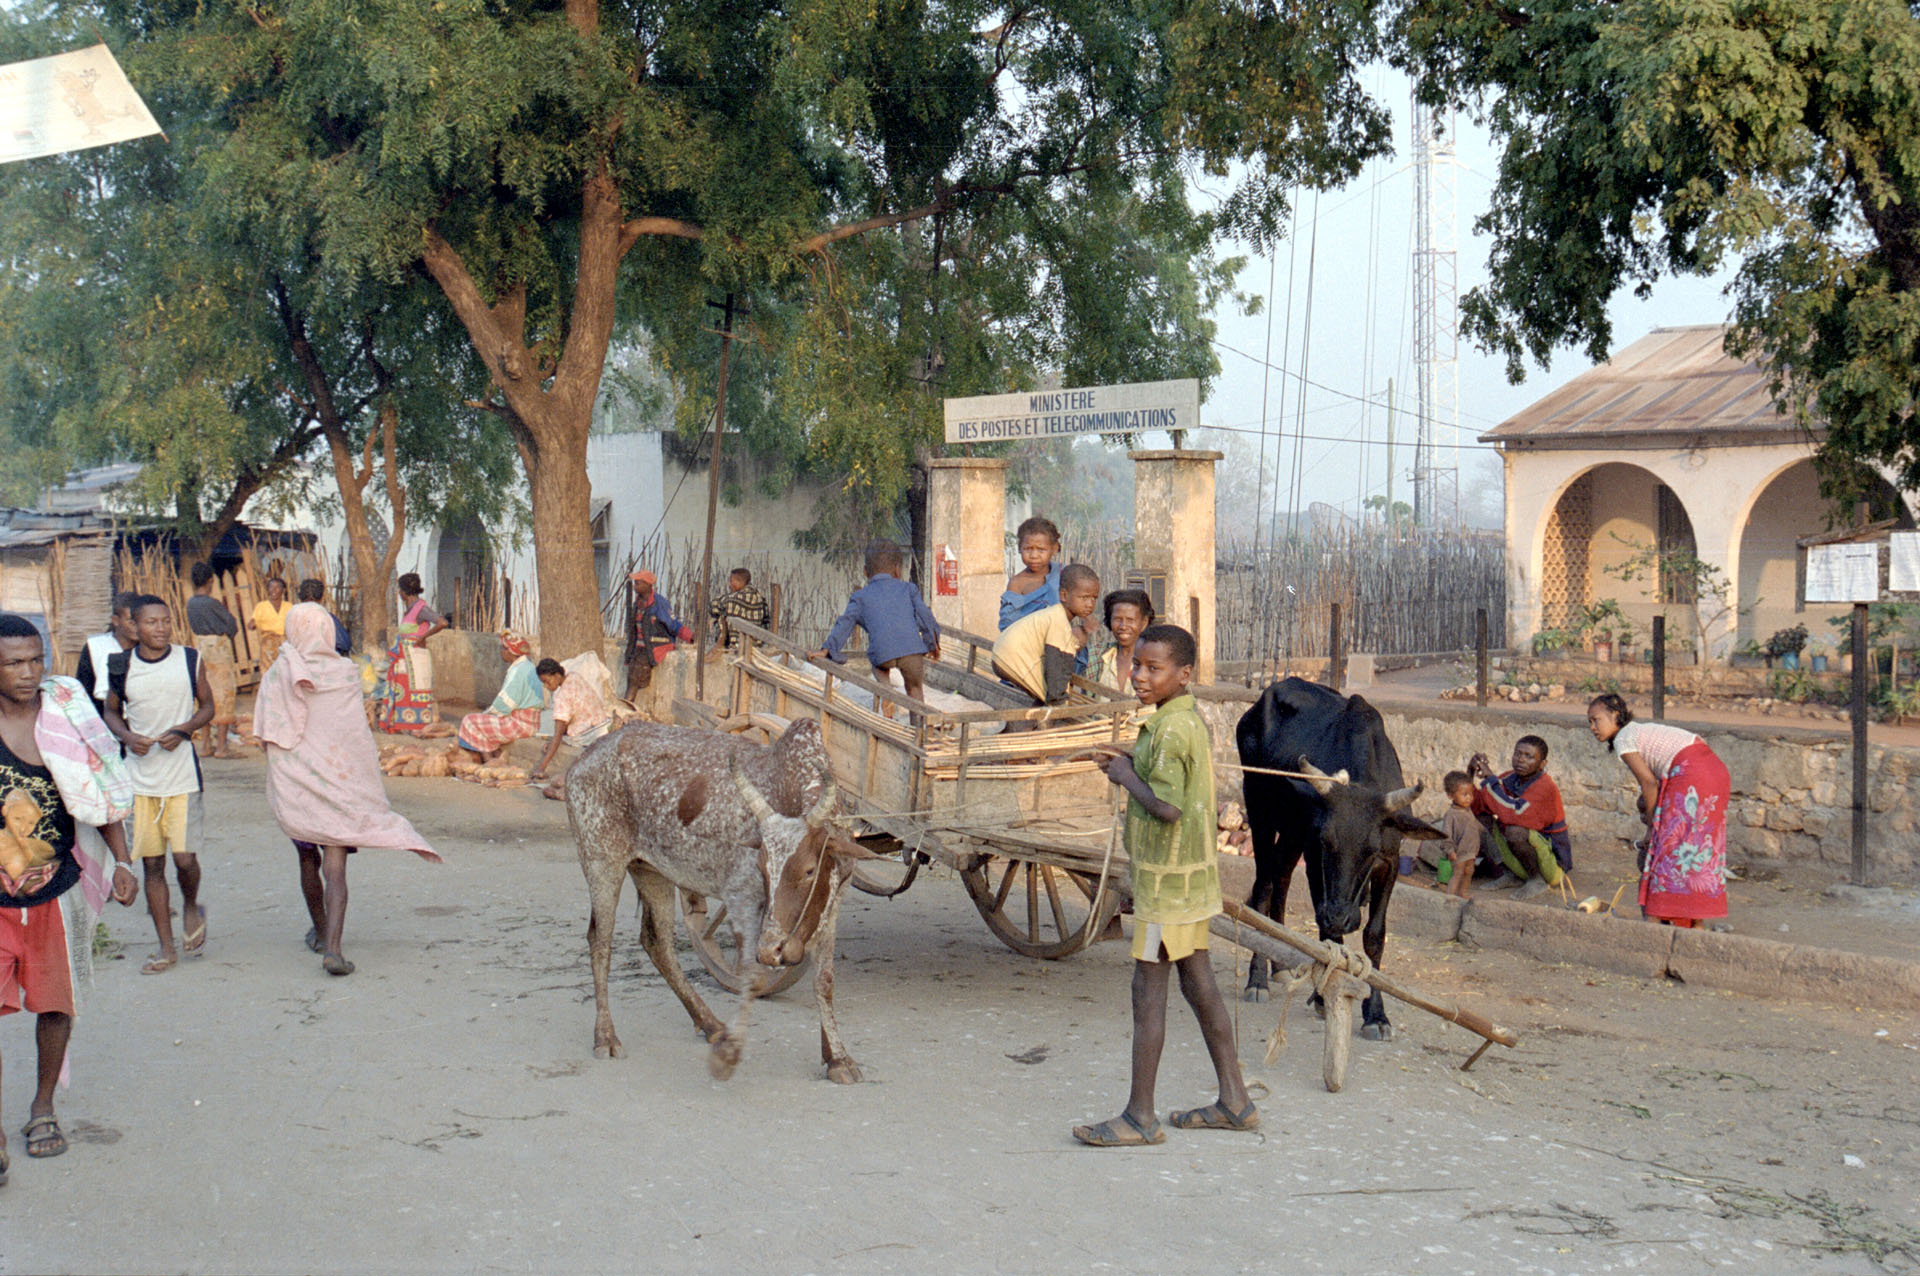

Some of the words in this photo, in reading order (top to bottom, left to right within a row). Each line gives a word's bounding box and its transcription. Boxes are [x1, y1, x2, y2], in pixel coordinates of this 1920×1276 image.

[1030, 391, 1095, 413] MINISTERE
[959, 422, 978, 439] DES
[981, 419, 1021, 437] POSTES
[1024, 417, 1039, 435] ET
[1043, 408, 1177, 434] TELECOMMUNICATIONS
